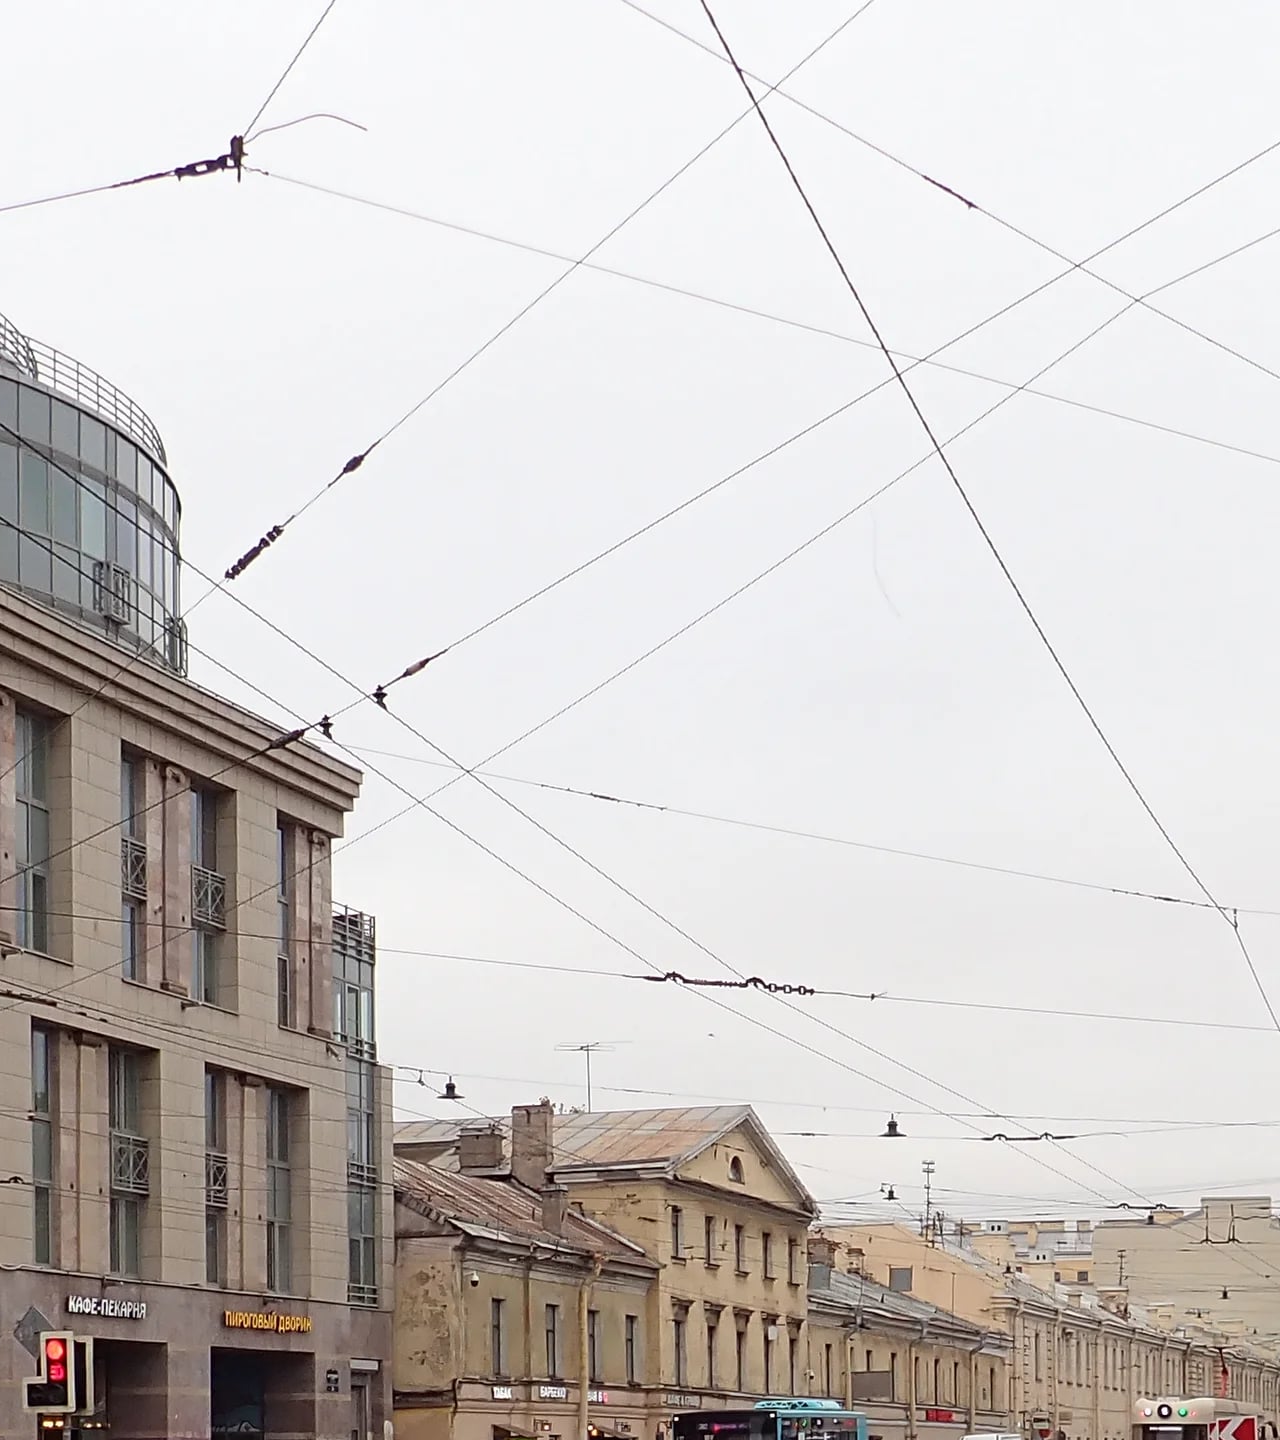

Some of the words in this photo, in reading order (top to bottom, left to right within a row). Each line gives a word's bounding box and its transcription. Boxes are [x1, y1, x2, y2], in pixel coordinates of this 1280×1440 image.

[68, 1295, 147, 1319] КАФЕ-ПЕКАРНЯ
[224, 1310, 277, 1330] ПИРОГОВЫЙ
[278, 1315, 312, 1334] ДВОРИК
